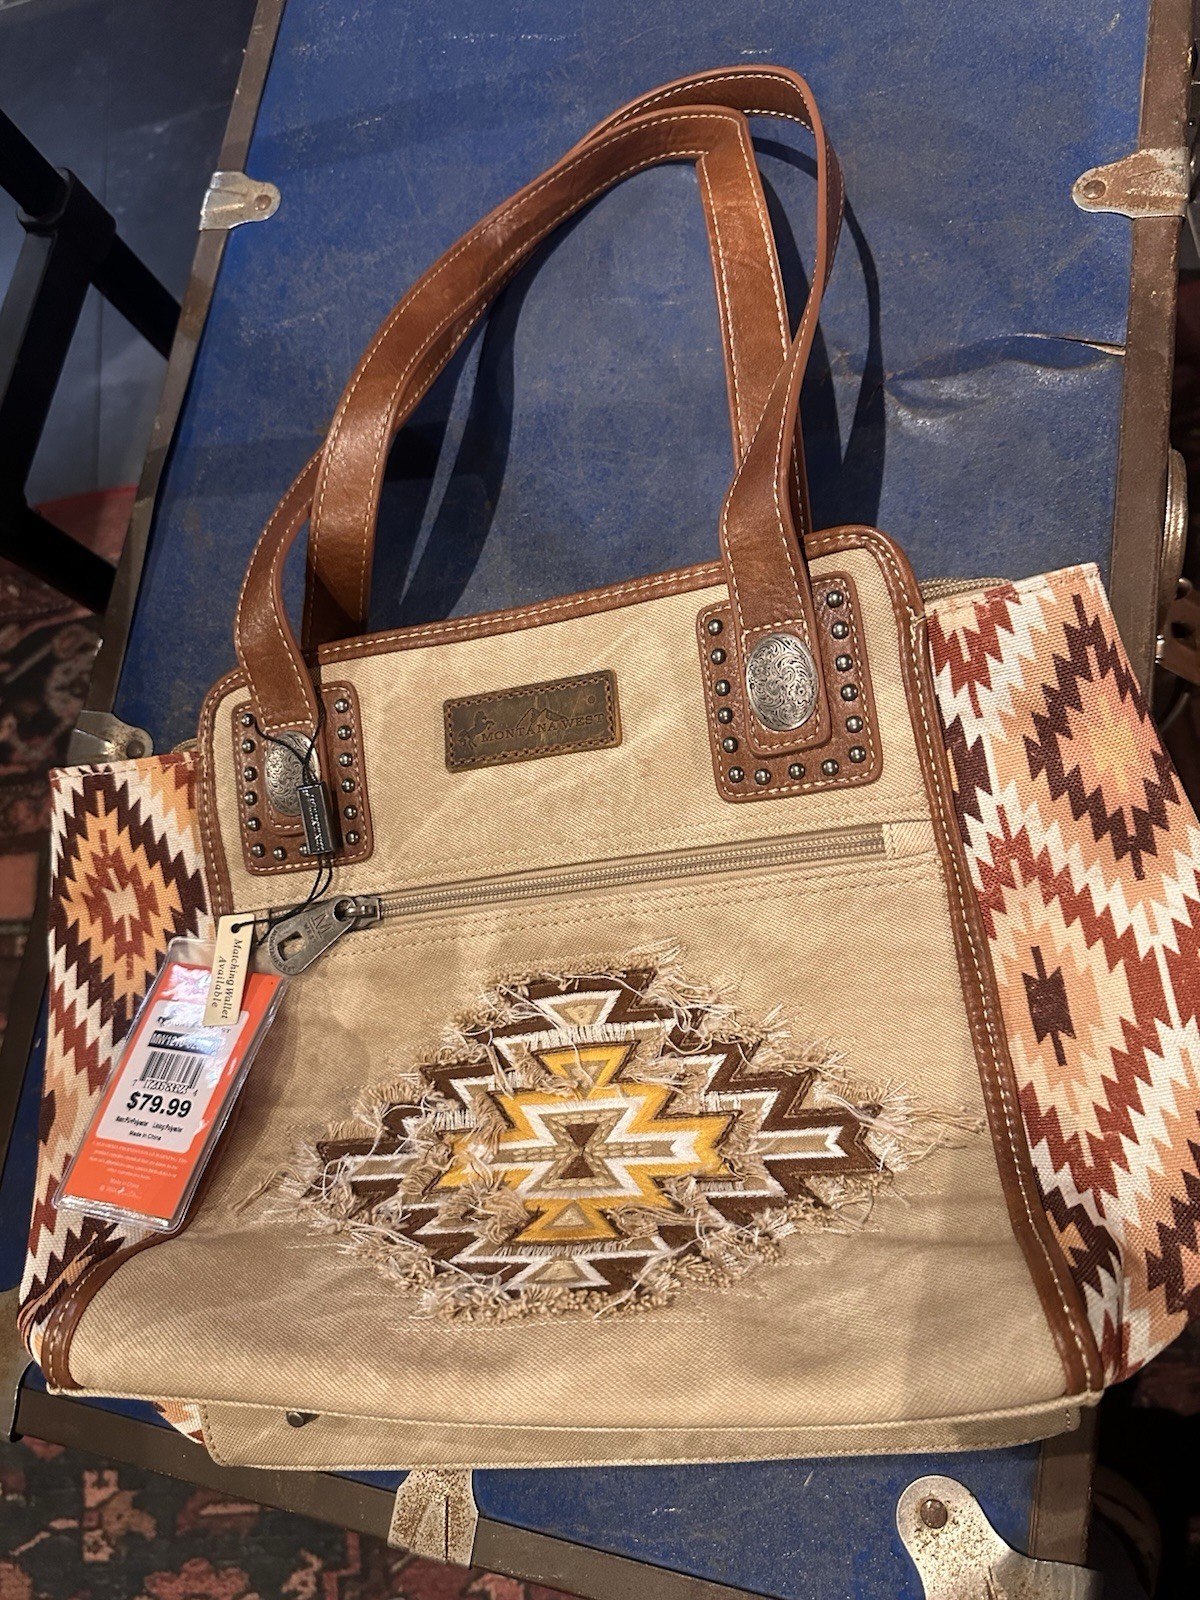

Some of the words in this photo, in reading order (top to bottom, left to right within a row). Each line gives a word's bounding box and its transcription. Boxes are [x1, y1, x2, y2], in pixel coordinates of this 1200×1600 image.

[481, 720, 559, 743] MONTANA
[561, 713, 605, 730] WEST
[225, 938, 243, 986] Matching
[211, 956, 227, 1009] Available
[221, 987, 234, 1019] Wallet
[127, 1091, 192, 1118] $79.99
[147, 1133, 162, 1141] China
